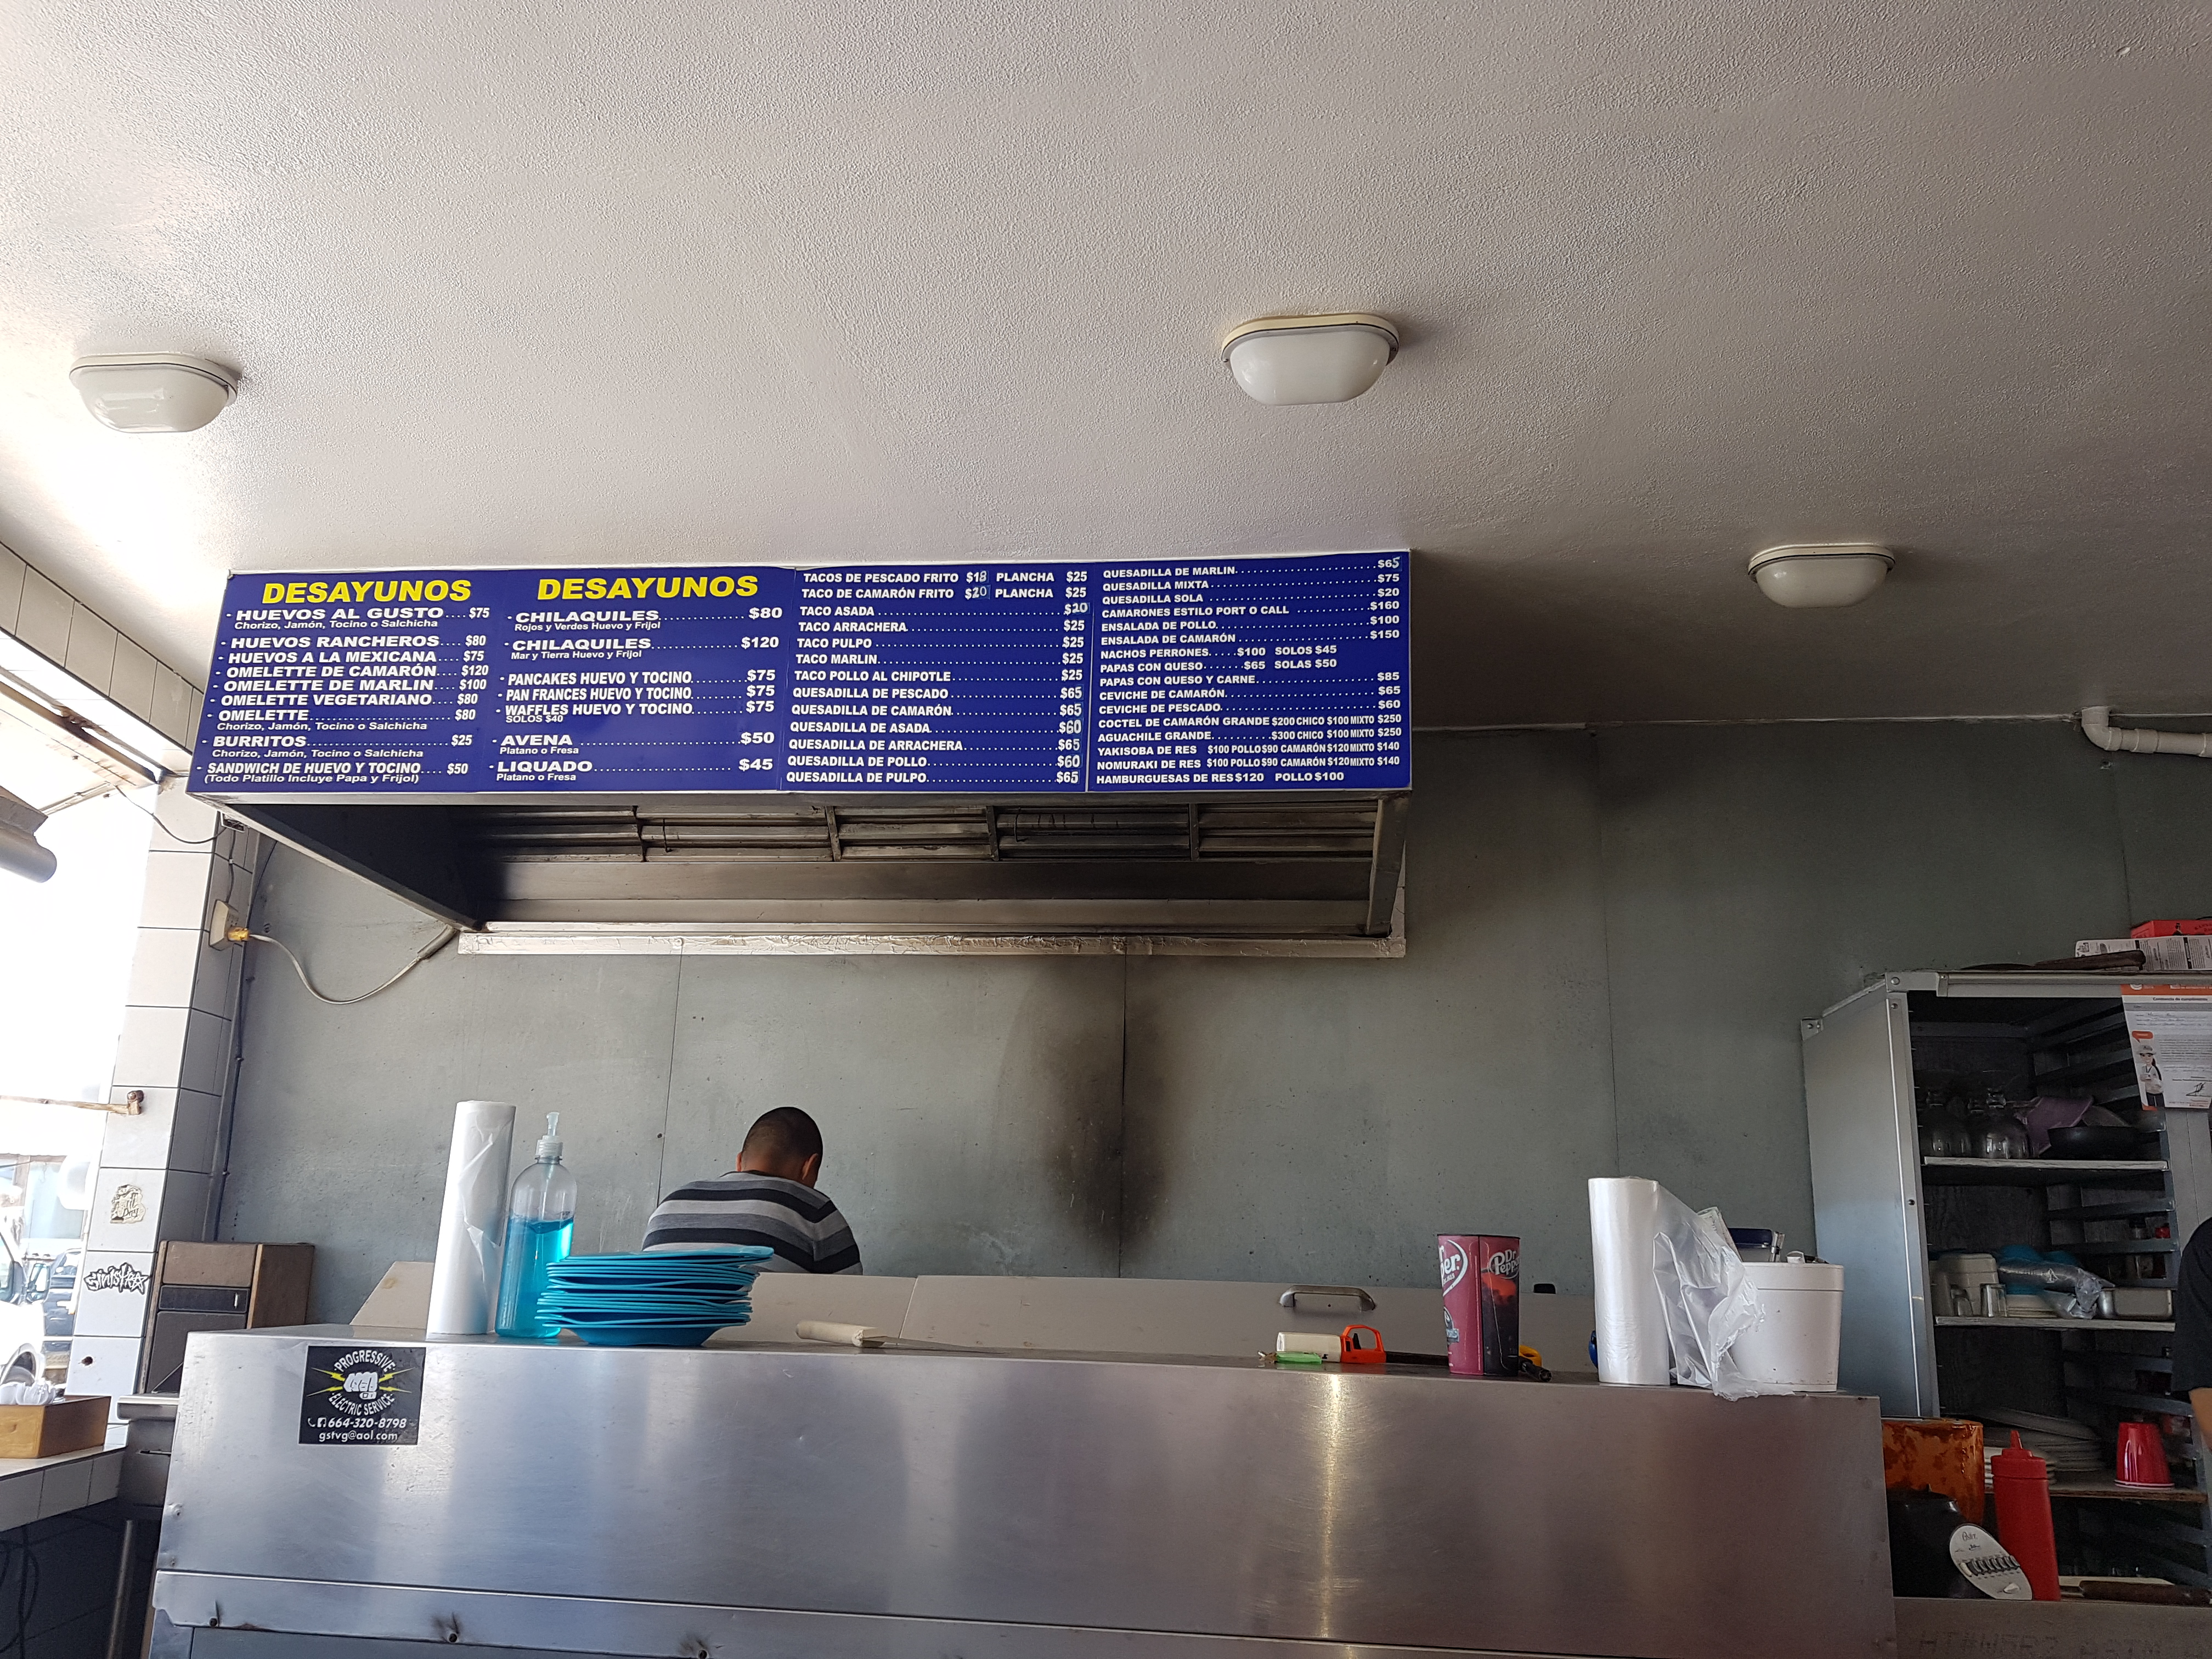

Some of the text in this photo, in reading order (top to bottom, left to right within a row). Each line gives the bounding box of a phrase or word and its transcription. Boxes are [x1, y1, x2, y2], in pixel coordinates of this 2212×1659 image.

[804, 571, 1087, 583] TACOS DE PESCADO FRITO $18 PLANCHA $25
[1103, 582, 1171, 591] QUESADILLA
[1378, 574, 1399, 583] $75
[262, 580, 471, 603] DESAYUNOS
[538, 576, 758, 600] DESAYUNOS
[1103, 588, 1399, 605] QUESADILLA SOLA $20
[236, 607, 489, 620] HUEVOS AL GUSTO $75
[516, 607, 782, 623] CHILAQUILES $80
[1102, 608, 1170, 618] CAMARONES
[1174, 607, 1212, 616] ESTILO
[1216, 607, 1246, 615] PORT
[1370, 601, 1399, 611] $160
[515, 624, 543, 632] Rojos
[635, 622, 660, 630] Frijol
[799, 619, 1084, 631] TACO ARRACHERA $25
[231, 635, 486, 648] HUEVOS RANCHEROS $80
[513, 637, 778, 651] CHILAQUILES $120
[797, 636, 1084, 648] TACO PULPO $25
[229, 651, 484, 663] HUEVOS A LA MEXICANA $75
[1101, 645, 1336, 659] NACHOS PERRONES $100 SOLOS $45
[796, 653, 1083, 665] TACO MARLIN $25
[227, 663, 488, 678] OMELETTE DE CAMARÓN $120
[508, 669, 775, 685] PANCAKES HUEVO Y TOCINO $75
[794, 669, 1082, 681] TACO POLLO AL CHIPOTLE $25
[1101, 678, 1134, 686] PAPAS
[1137, 677, 1160, 685] CON
[1164, 676, 1202, 685] QUESO
[1217, 675, 1255, 684] CARNE
[1378, 672, 1399, 681] $85
[222, 693, 478, 706] OMELETTE VEGETARIANO $80
[793, 687, 1082, 699] QUESADILLA DE PESCADO $65
[1099, 691, 1147, 700] CEVICHE
[1169, 688, 1224, 698] CAMARÓN
[1379, 686, 1400, 695] $65
[505, 701, 774, 715] WAFFLES HUEVO Y TOCINO $75
[219, 709, 476, 721] OMELETTE $80
[505, 715, 563, 723] SOLOS $40
[501, 732, 774, 746] AVENA $50
[789, 739, 1080, 751] QUESADILLA DE ARRACHERA $65
[1098, 742, 1399, 755] YAKISOBA DE RES $100 POLLO $90 CAMARÓN $120 MIXTO $140
[207, 763, 468, 775] SANDWICH DE HUEVO Y TOCINO $50
[498, 759, 772, 772] LIQUADO $45
[205, 775, 239, 783] (Todo
[288, 775, 332, 783] Incluye
[336, 775, 367, 783] Papa
[382, 775, 419, 783] Frijol)
[1097, 774, 1189, 783] HAMBURGUESAS
[1212, 774, 1233, 782] RES
[1235, 773, 1263, 782] $120
[1314, 772, 1344, 781] $100
[334, 1350, 396, 1372] PROGRESSIVE
[329, 1393, 395, 1416] ELECTRIC SERVICE
[328, 1418, 407, 1428] 664-320-8798
[319, 1430, 398, 1442] gstvg@aol.com
